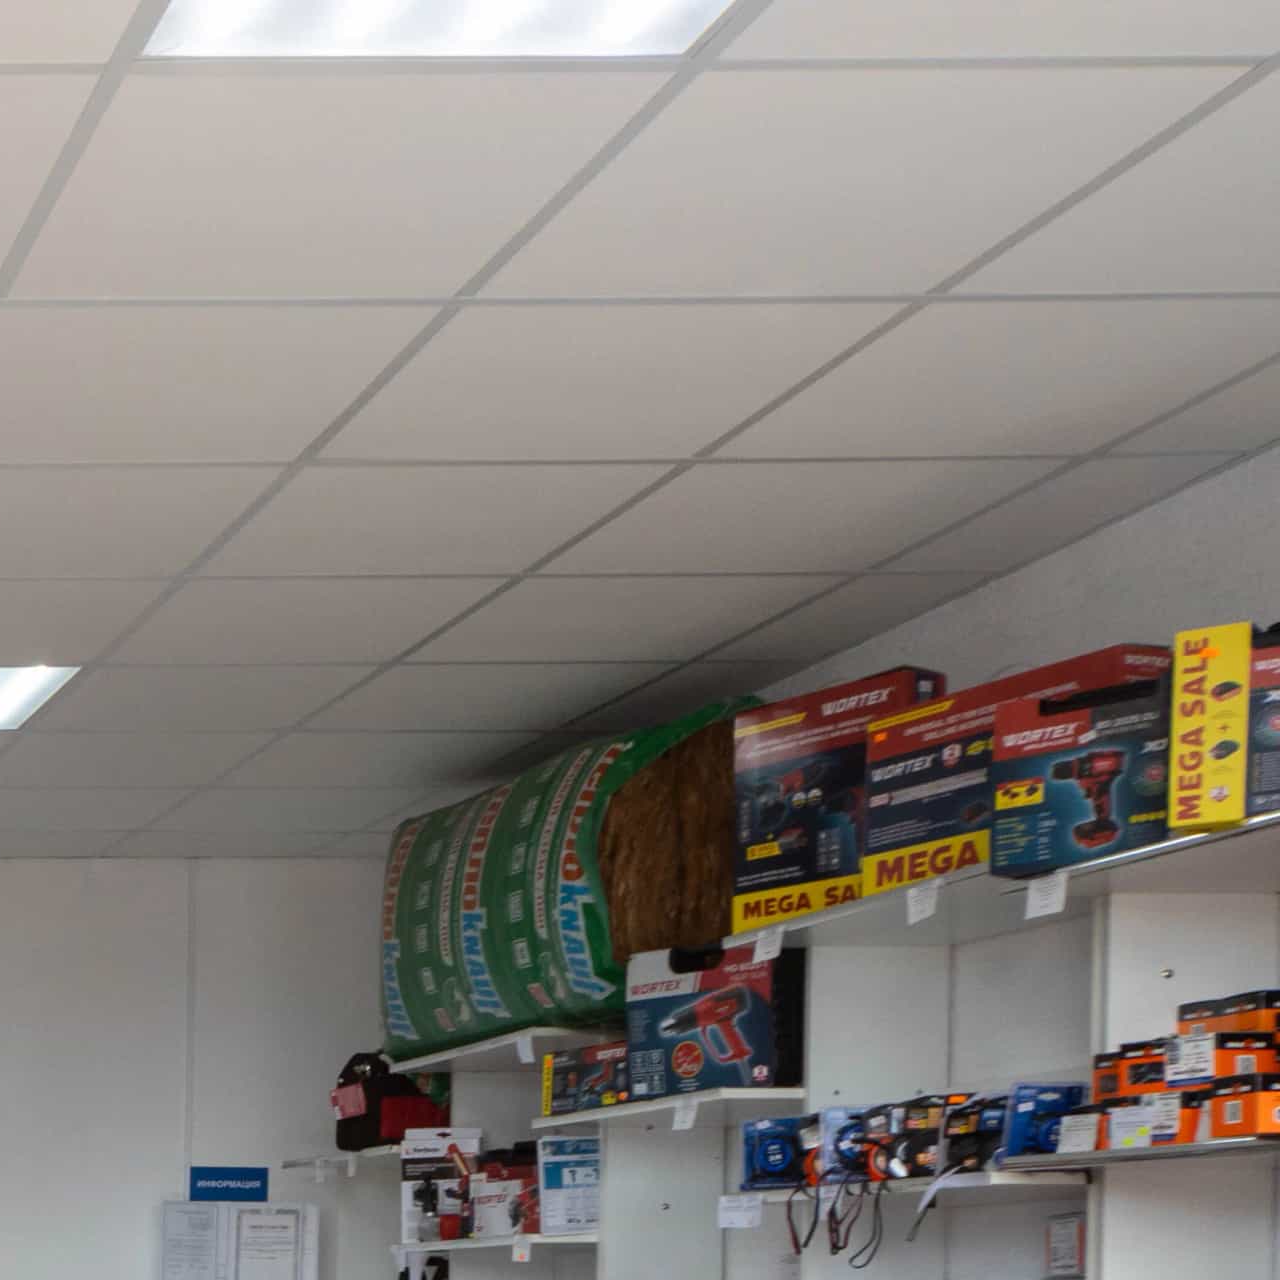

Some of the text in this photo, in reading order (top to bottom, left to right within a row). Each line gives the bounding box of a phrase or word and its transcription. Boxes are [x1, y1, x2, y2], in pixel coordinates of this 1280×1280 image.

[821, 687, 896, 717] WORTEX
[1002, 720, 1086, 749] WORTEX
[870, 753, 939, 783] WORTEX
[1176, 725, 1206, 821] MEGA
[875, 839, 980, 888] MEGA
[743, 883, 864, 921] MEGA SA
